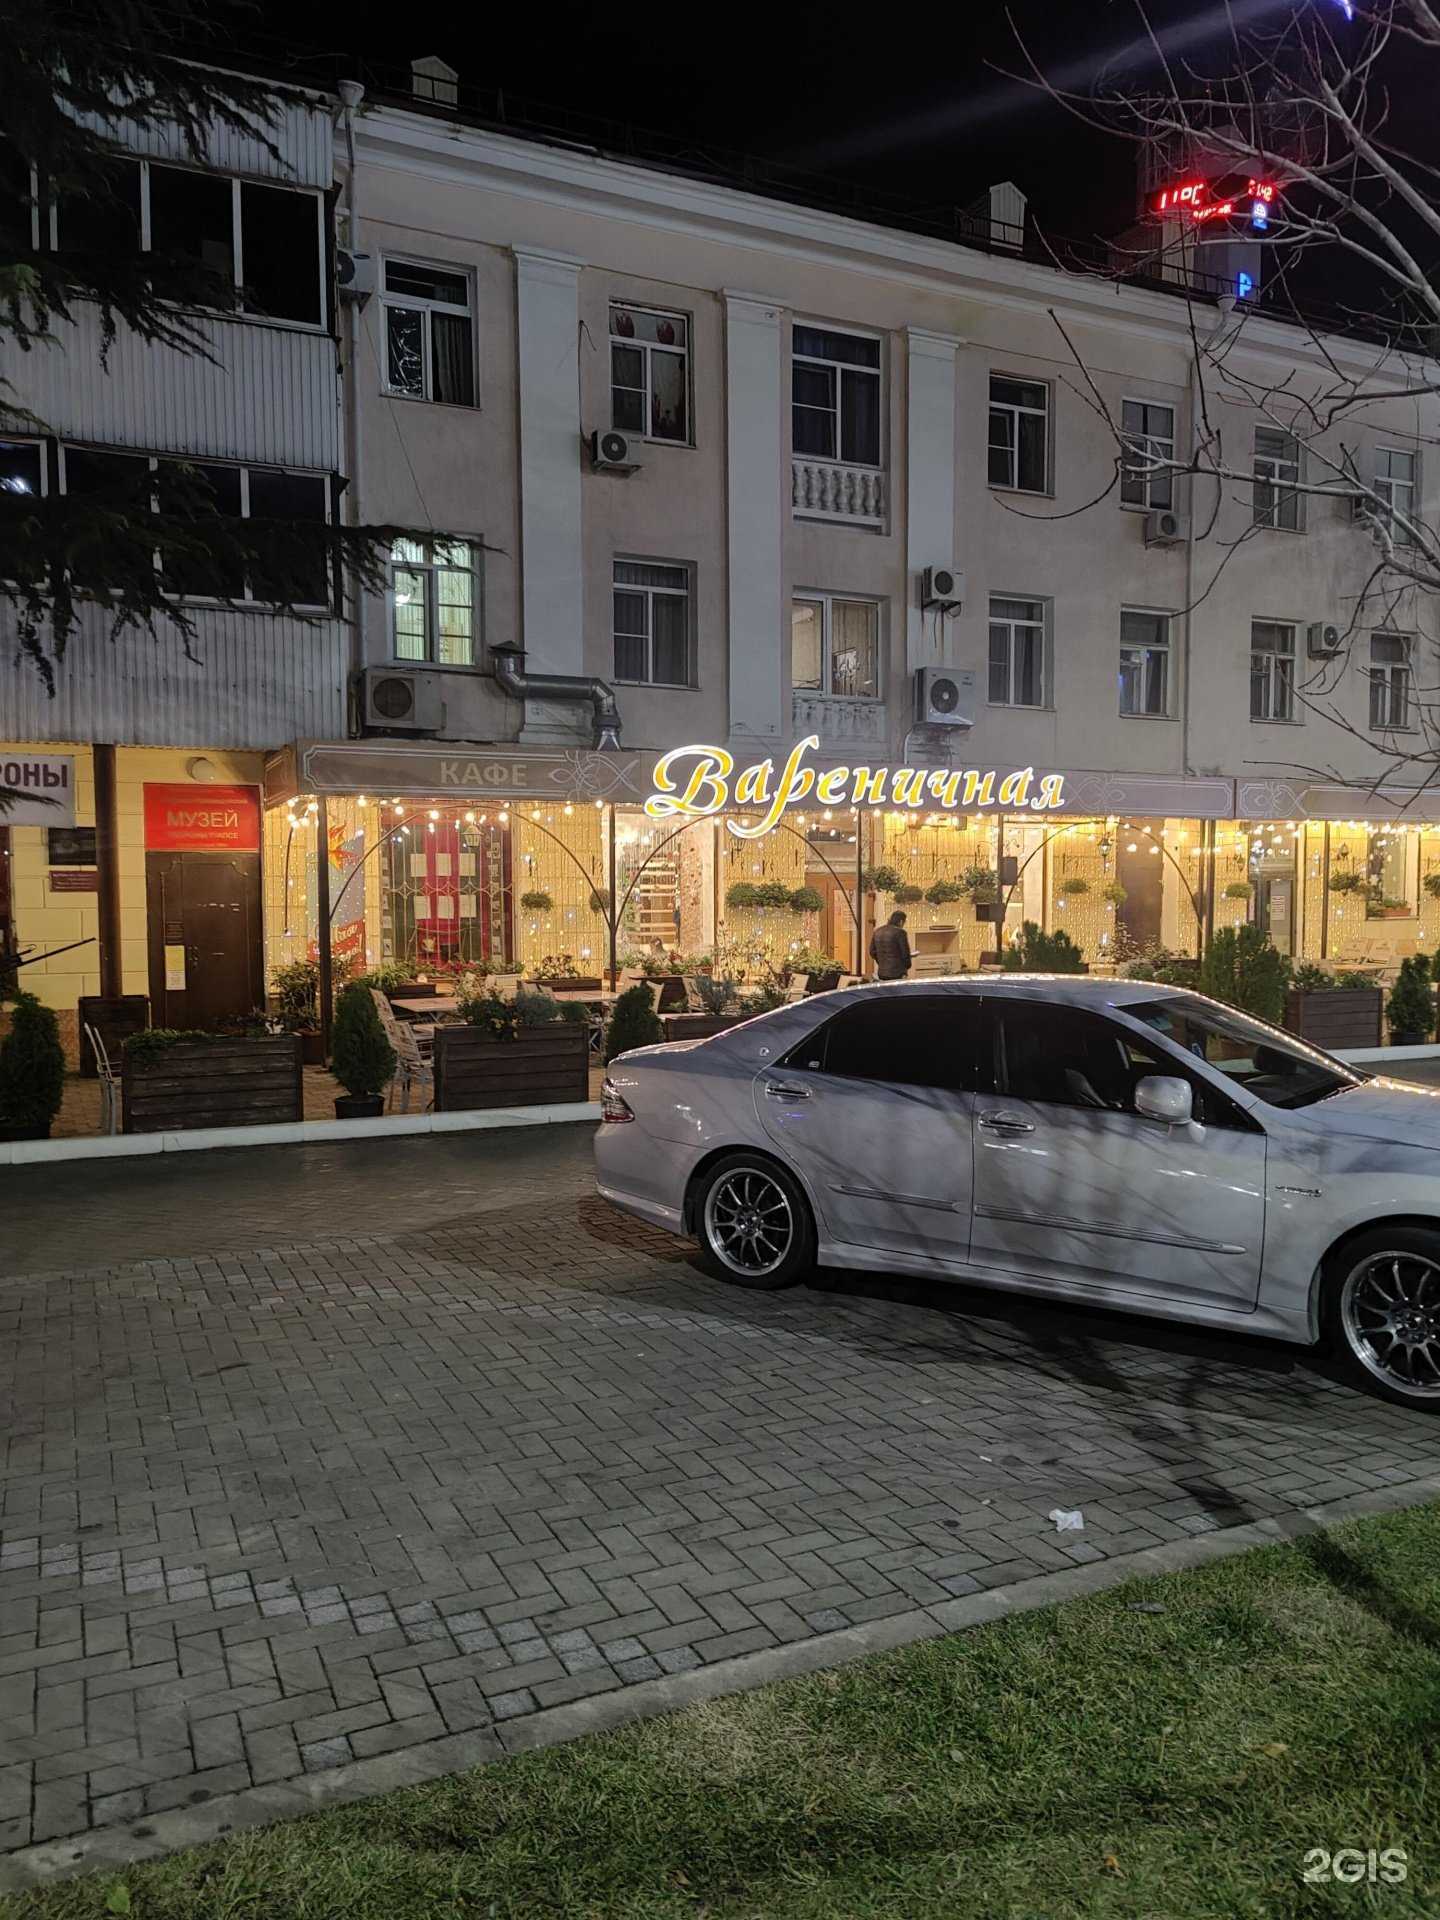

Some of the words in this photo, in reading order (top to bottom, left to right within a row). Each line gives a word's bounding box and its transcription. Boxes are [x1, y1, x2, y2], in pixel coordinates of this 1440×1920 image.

[440, 760, 528, 787] КАФЕ
[644, 735, 1067, 839] Вареничная
[166, 808, 239, 828] МУЗЕЙ
